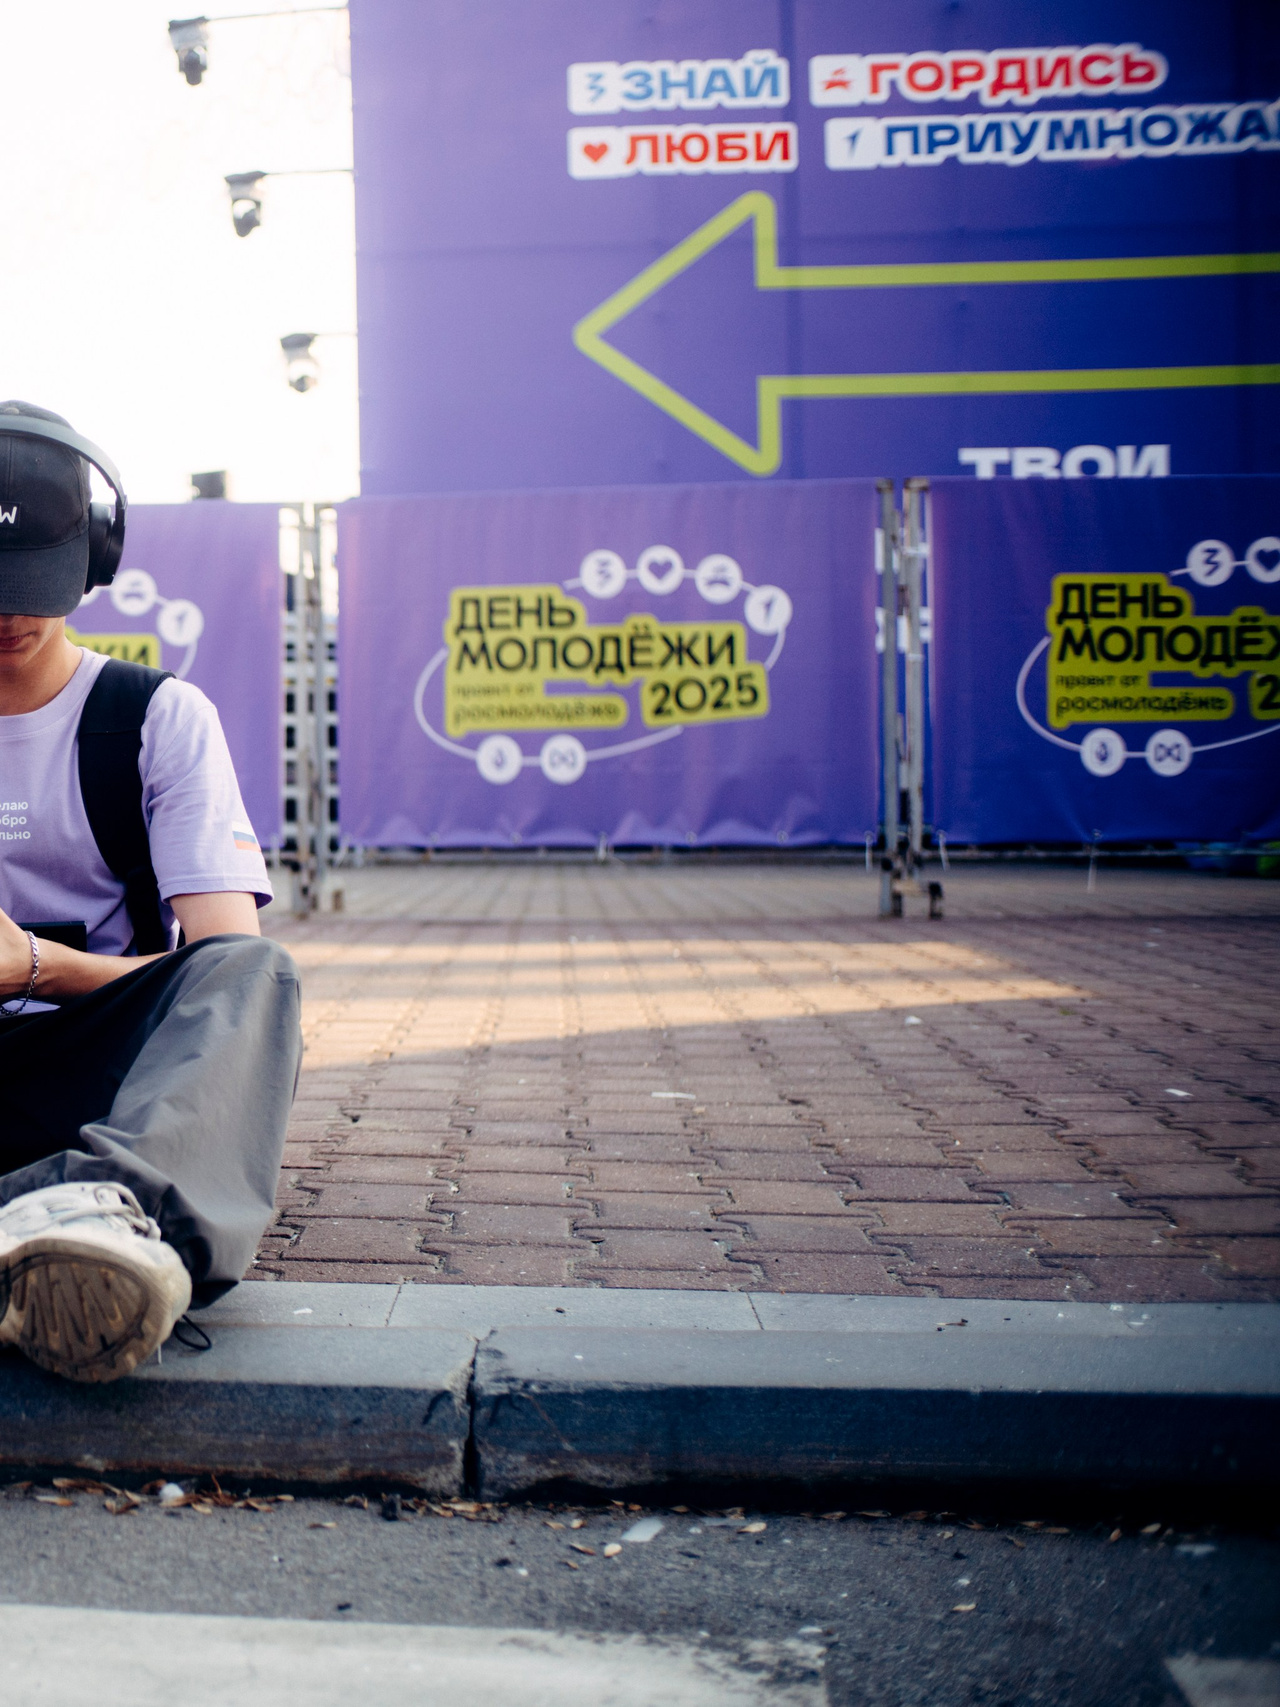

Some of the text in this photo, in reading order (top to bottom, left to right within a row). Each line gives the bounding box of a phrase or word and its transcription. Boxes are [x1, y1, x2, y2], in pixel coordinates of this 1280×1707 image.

[622, 57, 781, 101] ЗНАЙ
[869, 50, 1158, 98] ГОРДИСЬ
[624, 130, 791, 166] ЛЮБИ
[885, 107, 1280, 156] ПРИУМНОЖА
[455, 596, 577, 635] ДЕНЬ
[1056, 582, 1184, 625] ДЕНЬ
[455, 624, 738, 675] МОЛОДЁЖИ
[1056, 615, 1280, 668] МОЛОДЁ
[650, 672, 760, 718] 2025
